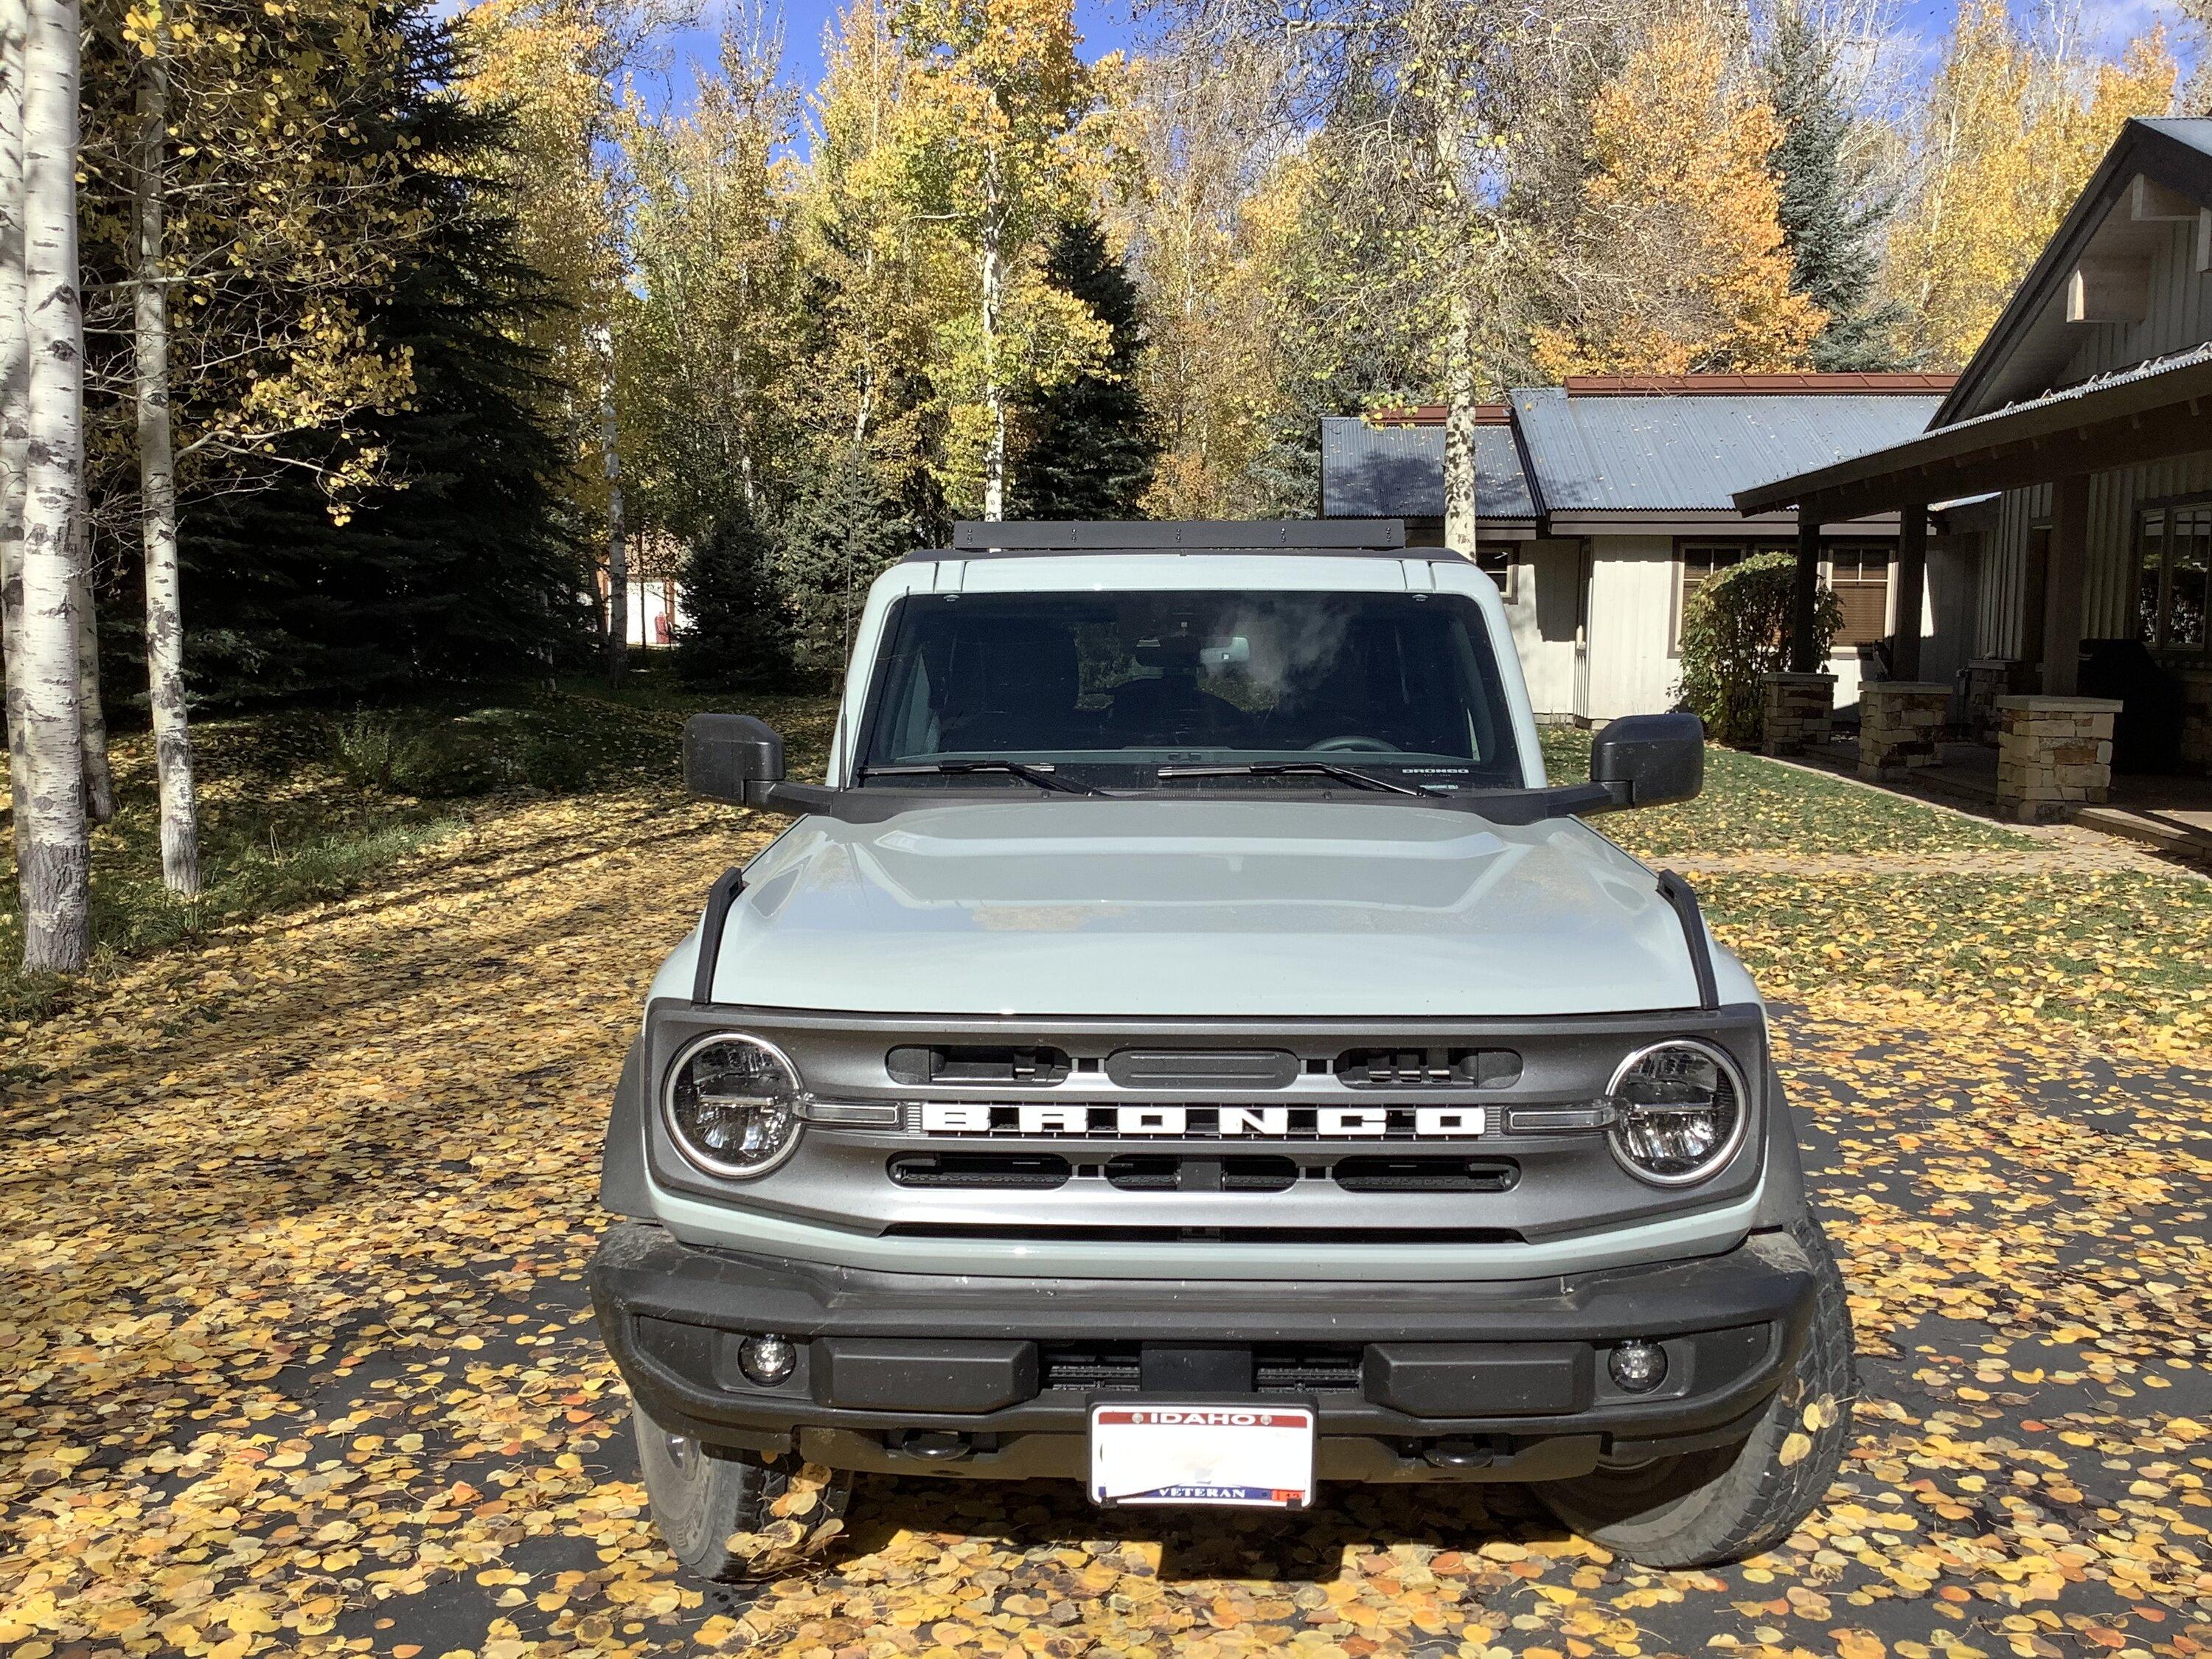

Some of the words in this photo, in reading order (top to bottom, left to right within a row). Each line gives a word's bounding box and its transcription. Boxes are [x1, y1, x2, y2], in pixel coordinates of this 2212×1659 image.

[922, 1104, 1485, 1135] BRONCO
[1150, 1413, 1256, 1425] IDAHO
[1158, 1488, 1245, 1498] VETERAN
